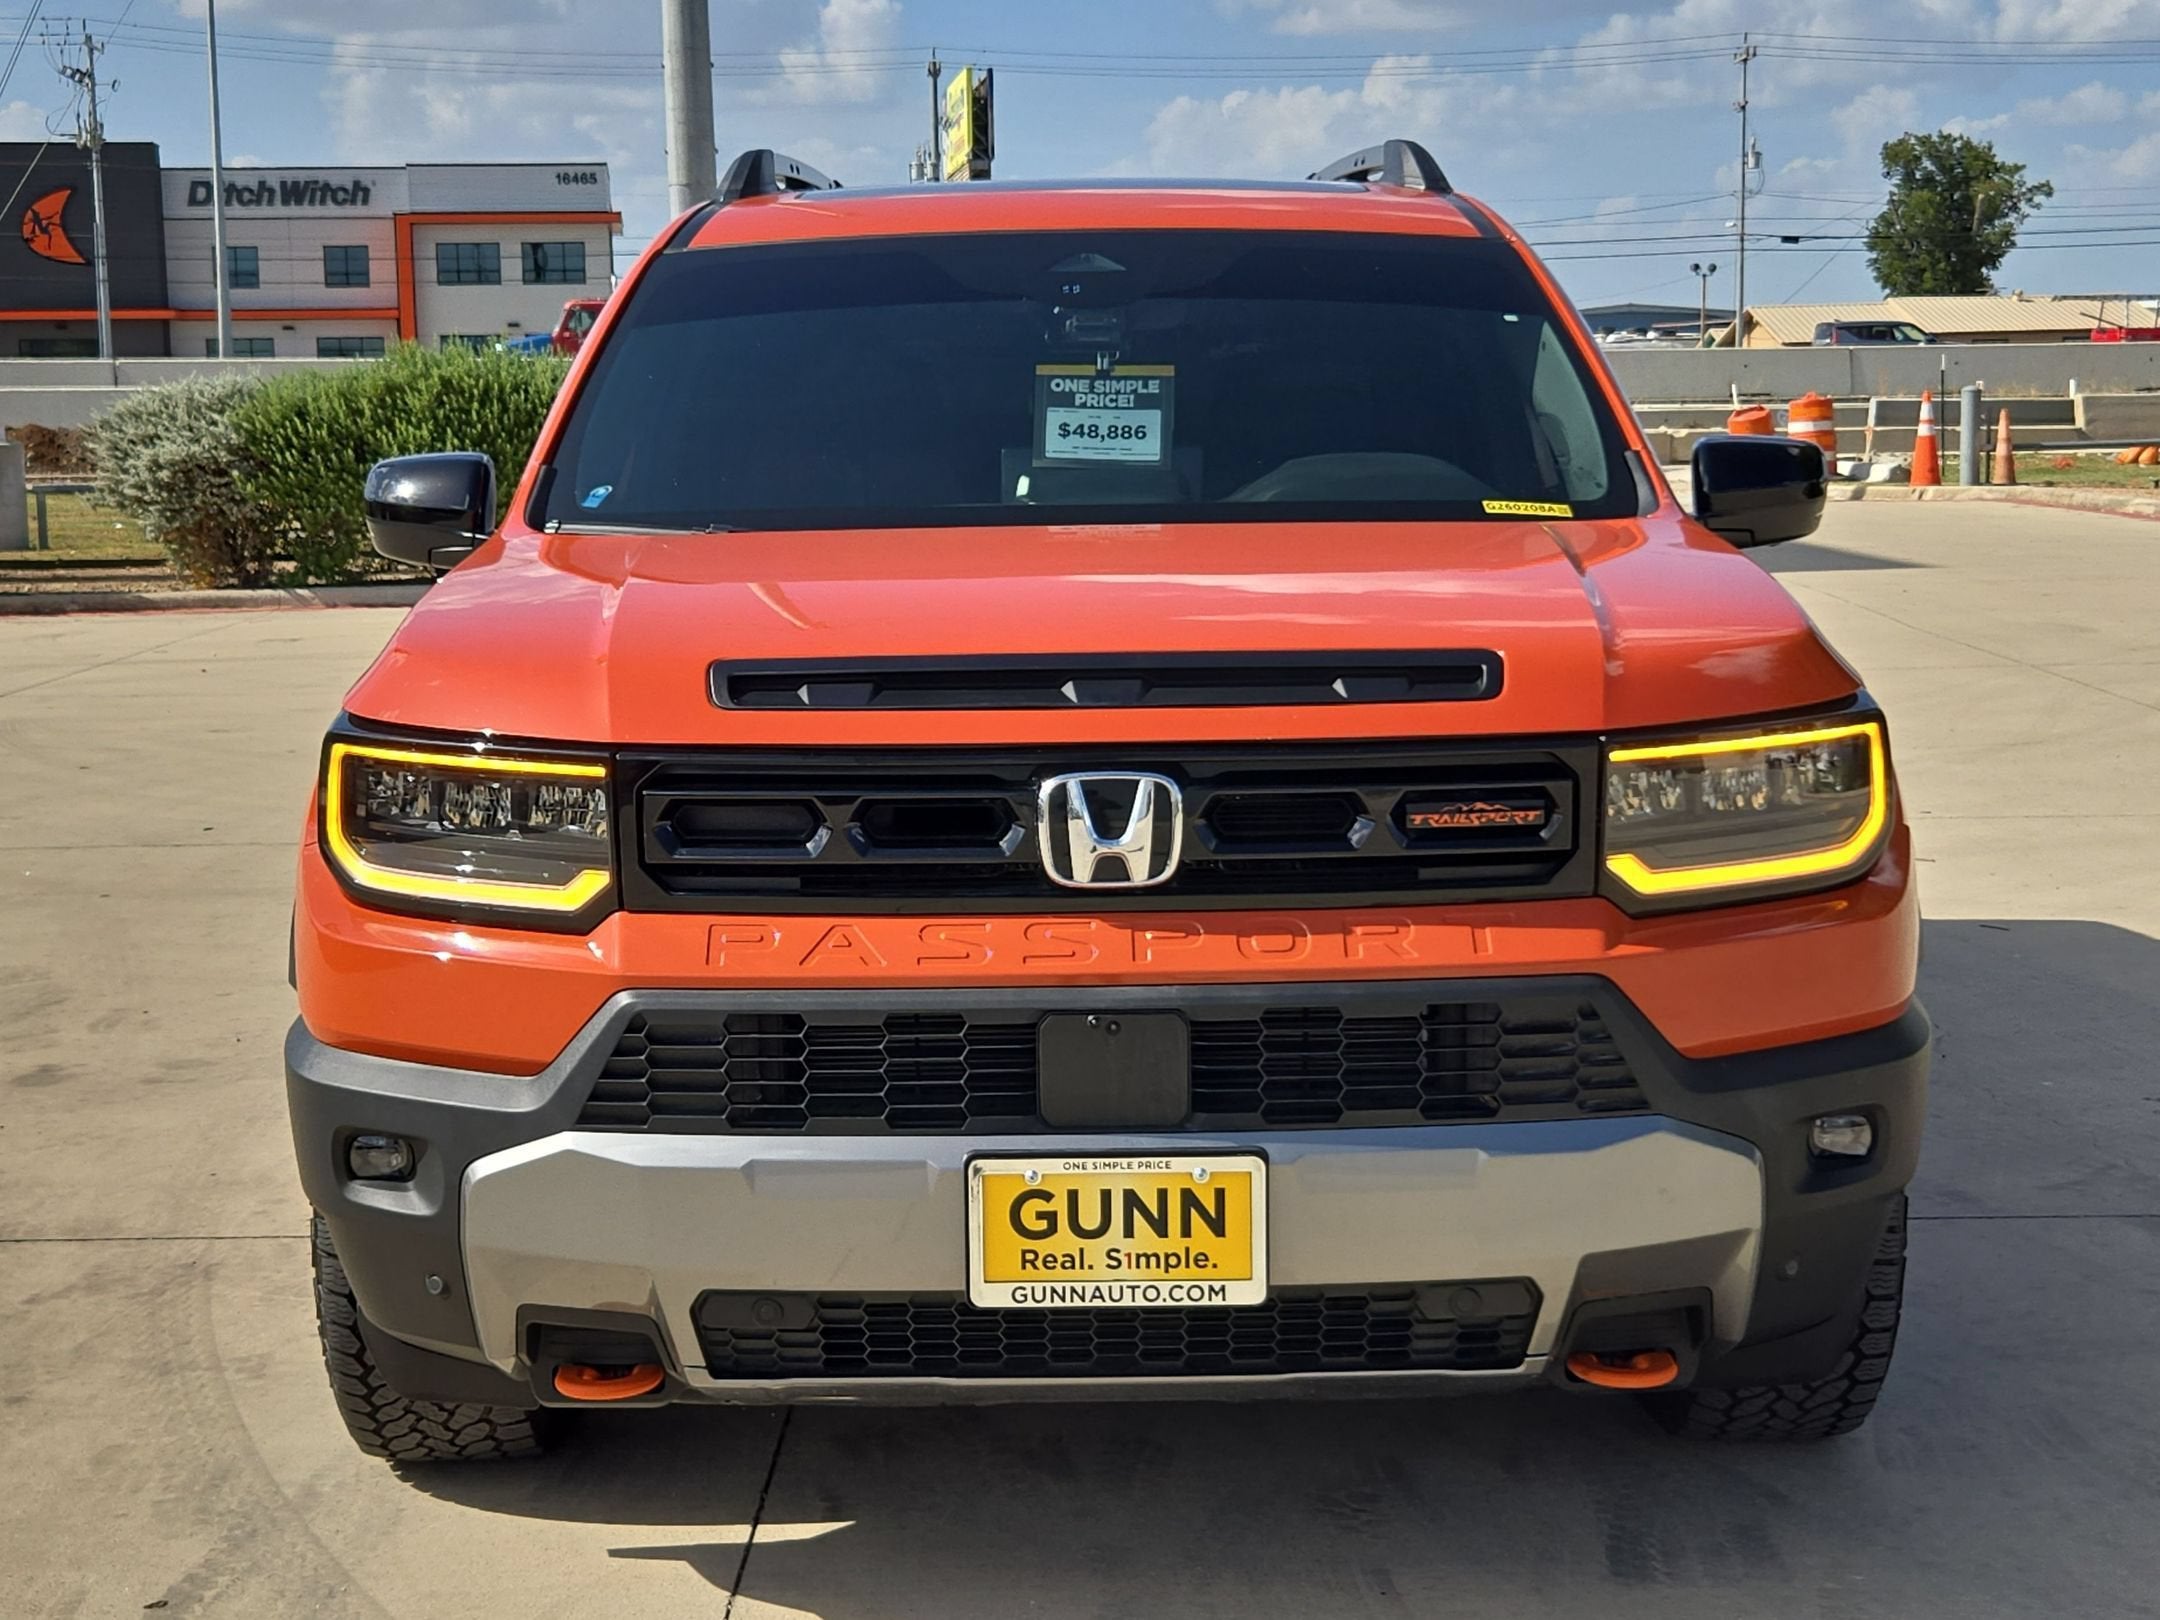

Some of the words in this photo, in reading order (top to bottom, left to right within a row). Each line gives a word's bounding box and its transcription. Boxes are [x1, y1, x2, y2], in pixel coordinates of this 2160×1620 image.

[555, 172, 598, 186] 16465
[187, 180, 276, 207] Dtch
[279, 180, 371, 207] Witch
[1050, 378, 1090, 393] ONE
[1093, 379, 1160, 394] SIMPLE
[1074, 393, 1135, 408] PRICE!
[1058, 422, 1147, 443] $48,886
[1409, 810, 1542, 827] TRAILSPORT
[705, 911, 1515, 967] PASSPORT
[1062, 1161, 1088, 1171] ONE
[1092, 1160, 1133, 1171] SIMPLE
[1137, 1160, 1172, 1170] PRICE
[1008, 1187, 1227, 1241] GUNN
[1020, 1247, 1094, 1271] Real.
[1011, 1284, 1227, 1304] GUNNAUTO.COM
